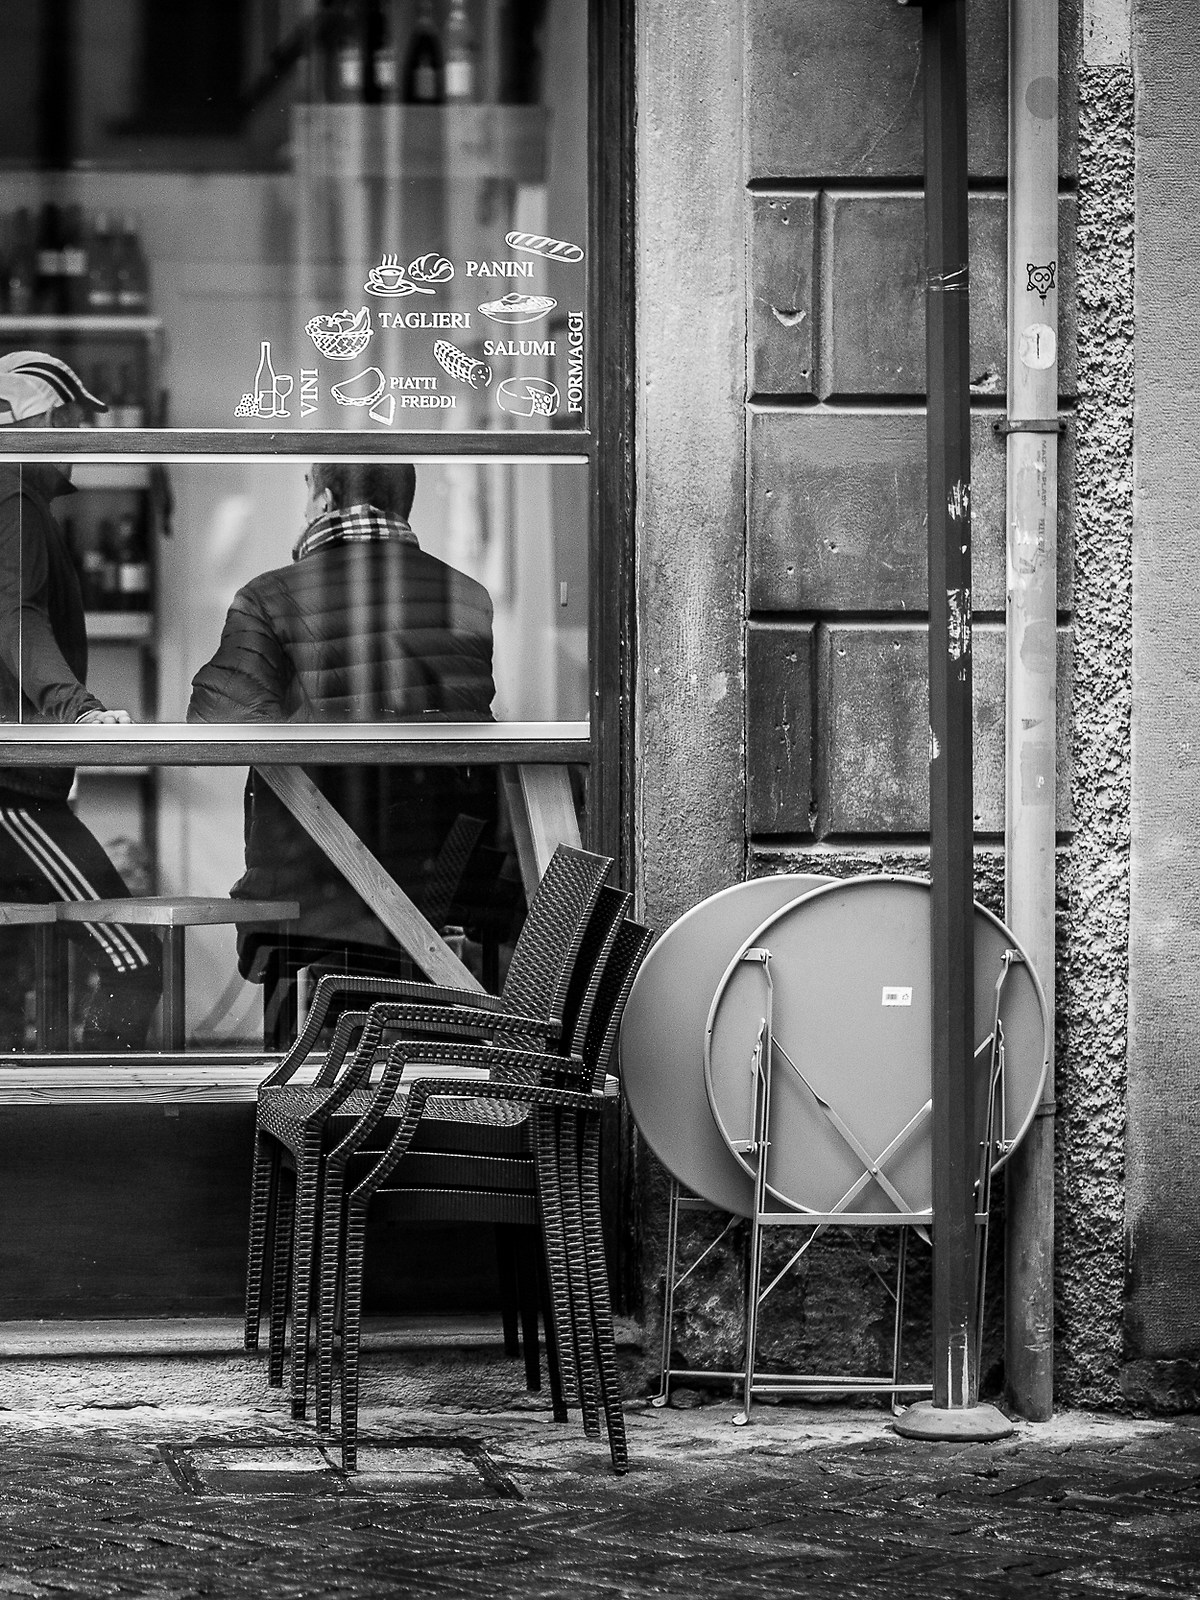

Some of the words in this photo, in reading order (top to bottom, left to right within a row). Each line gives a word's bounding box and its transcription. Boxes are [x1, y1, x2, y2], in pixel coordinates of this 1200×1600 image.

[465, 260, 535, 278] PANINI
[378, 312, 471, 329] TAGLIERI
[483, 340, 556, 356] SALUMI
[567, 311, 584, 413] FORMAGGI
[389, 376, 438, 390] PIATTI
[300, 368, 319, 418] VINI
[401, 395, 457, 408] FREDDI
